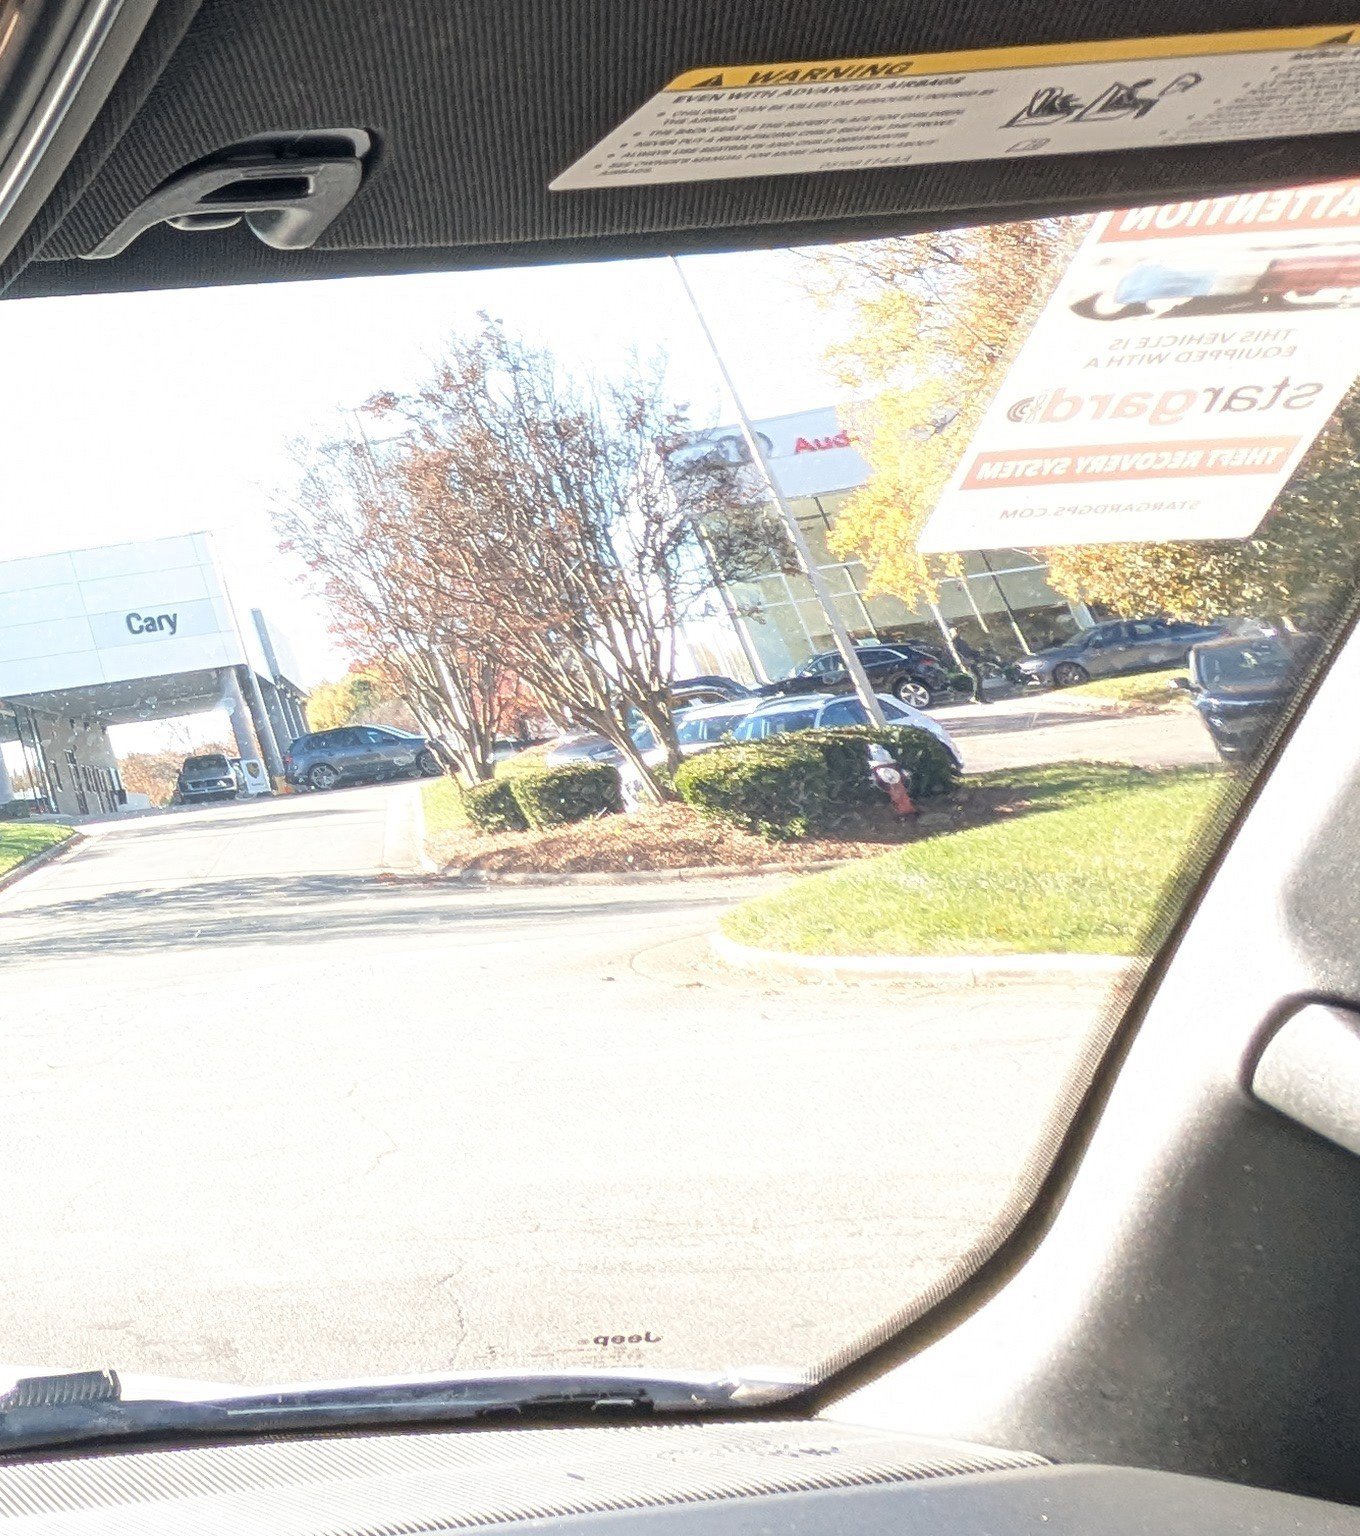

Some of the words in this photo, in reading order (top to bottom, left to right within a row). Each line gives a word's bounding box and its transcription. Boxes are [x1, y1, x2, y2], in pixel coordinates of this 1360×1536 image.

[748, 62, 914, 84] WARNING
[672, 93, 726, 104] EVEN
[726, 90, 779, 100] WITH
[126, 612, 178, 636] Cary
